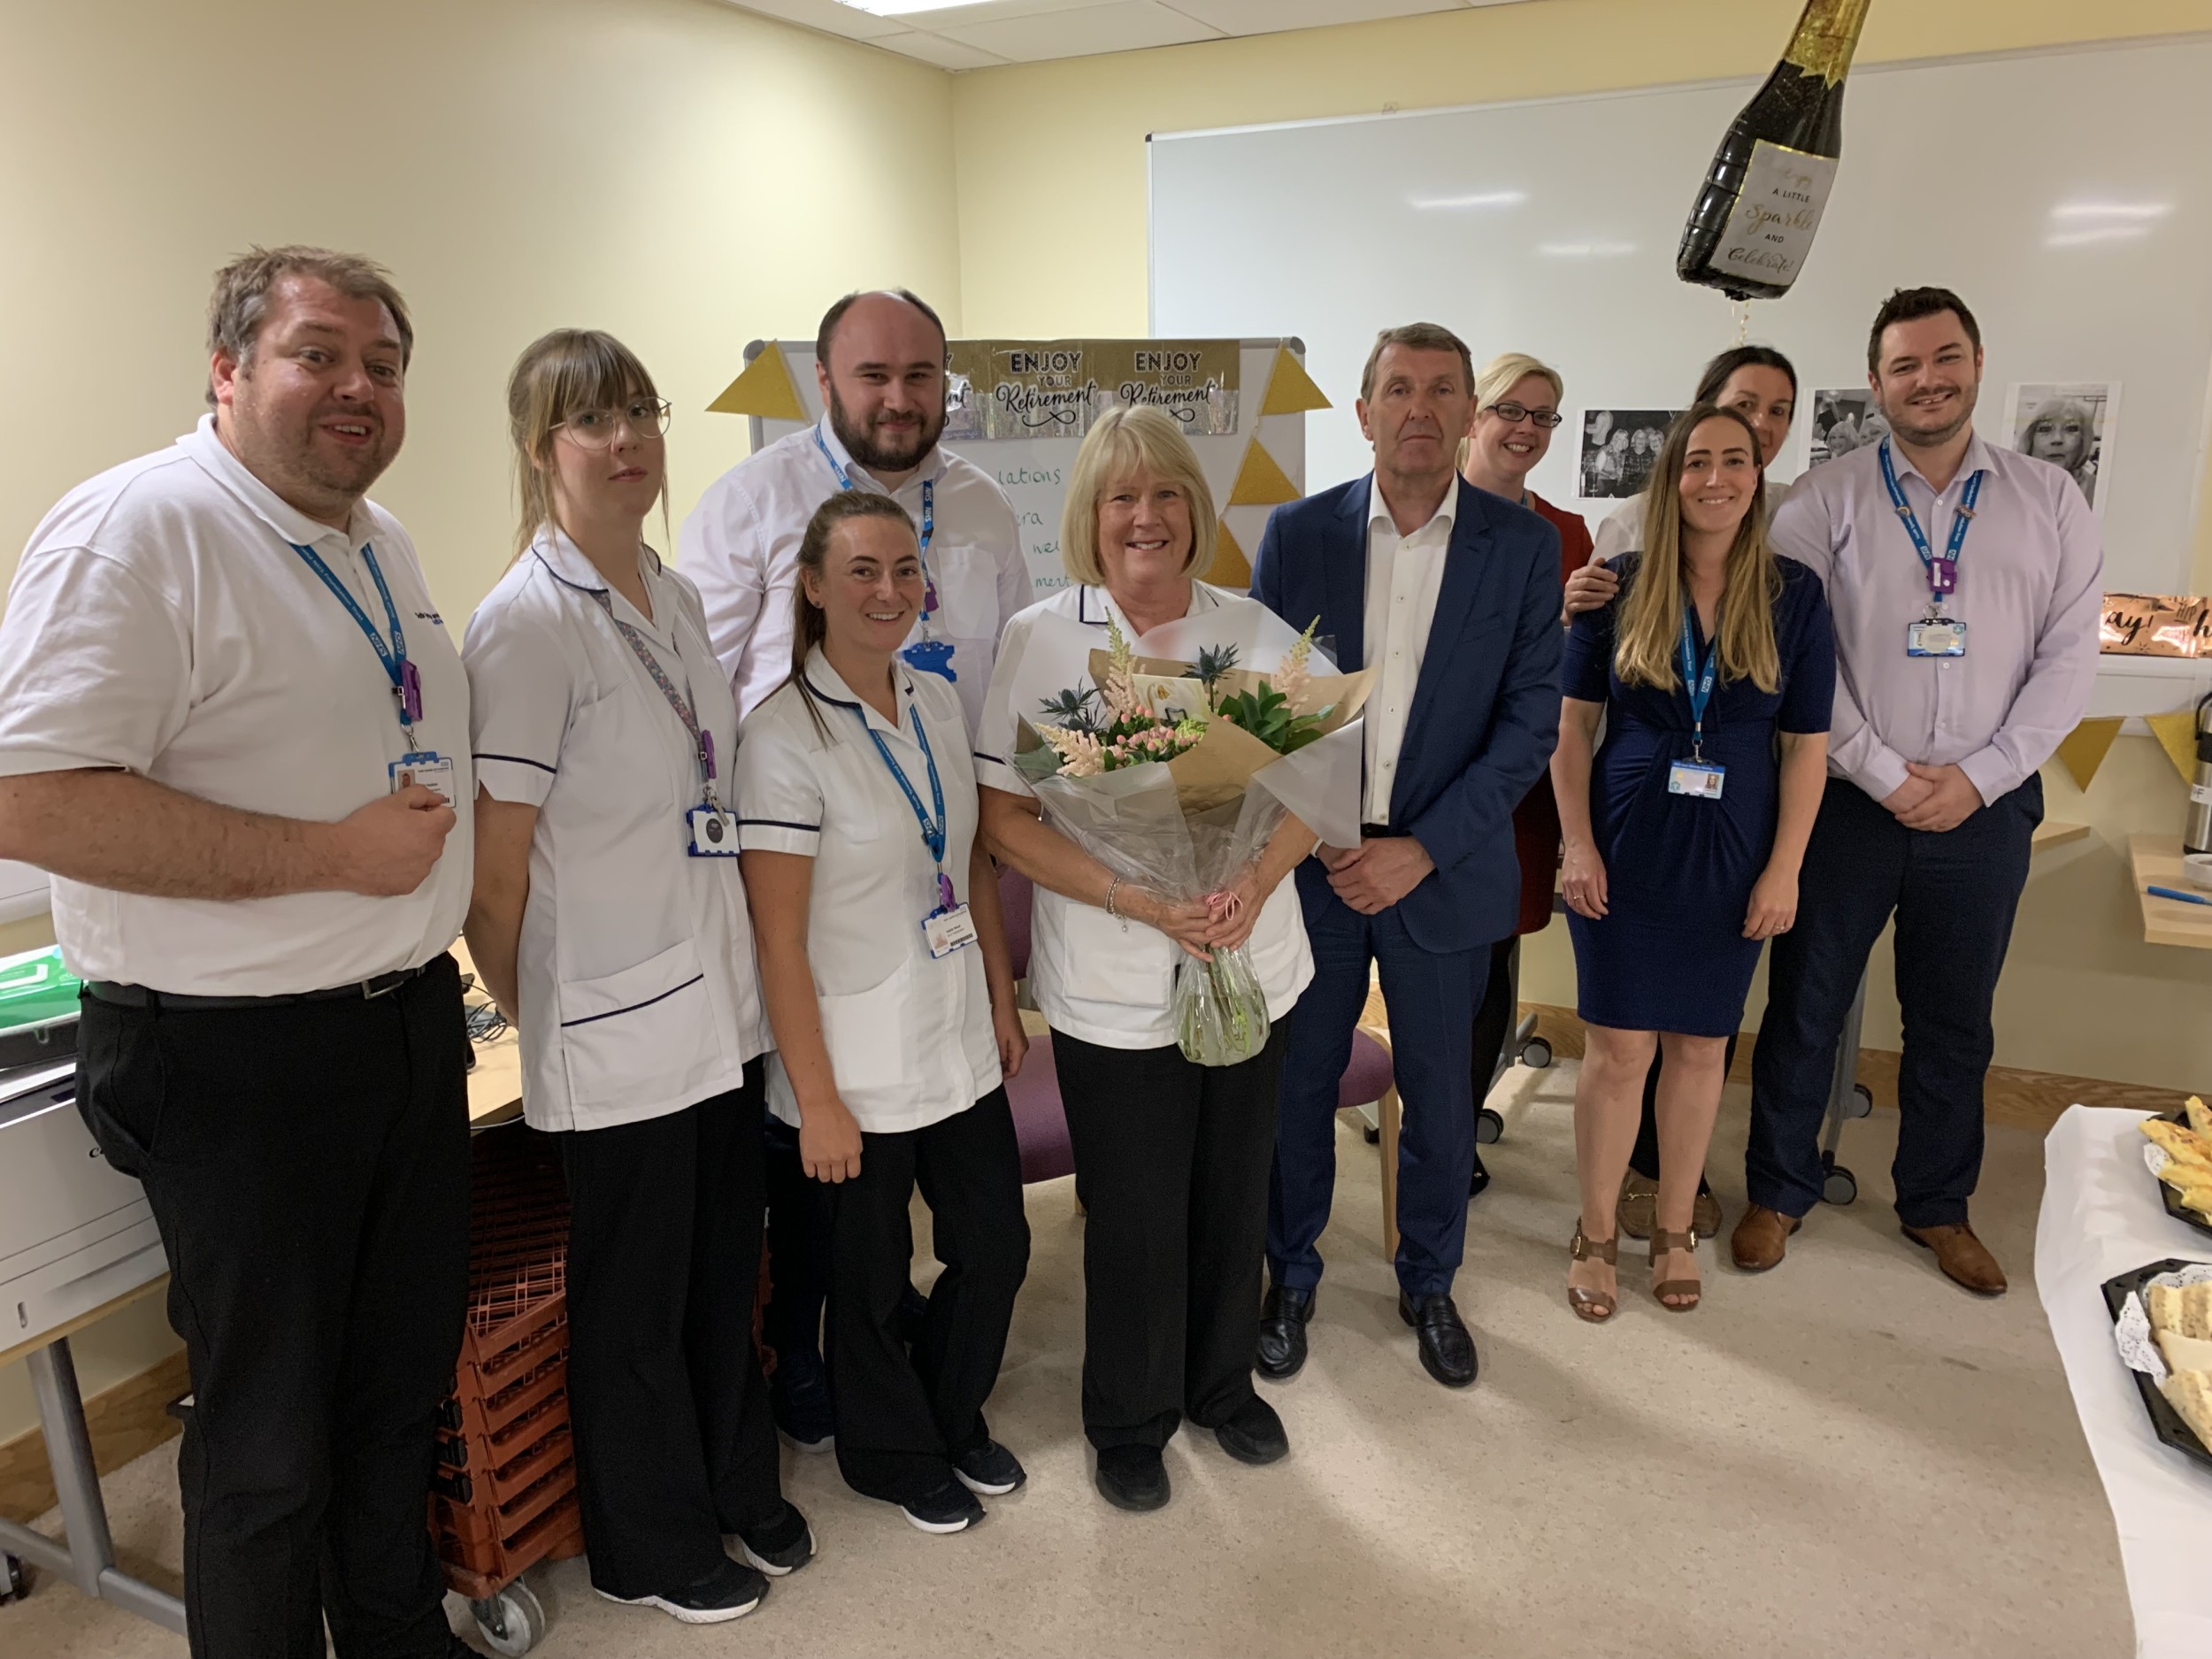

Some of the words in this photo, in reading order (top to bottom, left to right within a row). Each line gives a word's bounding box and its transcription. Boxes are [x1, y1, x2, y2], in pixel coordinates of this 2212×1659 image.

[1783, 190, 1811, 204] LITTLE
[1764, 234, 1785, 243] AND
[1011, 352, 1081, 372] ENJOY
[1135, 352, 1201, 371] ENJOY
[1038, 376, 1071, 387] YOUR
[1160, 374, 1191, 386] YOUR
[995, 380, 1097, 414] Retirement
[1119, 380, 1216, 408] Retirement
[370, 633, 388, 657] NHS
[1701, 676, 1712, 692] NHS
